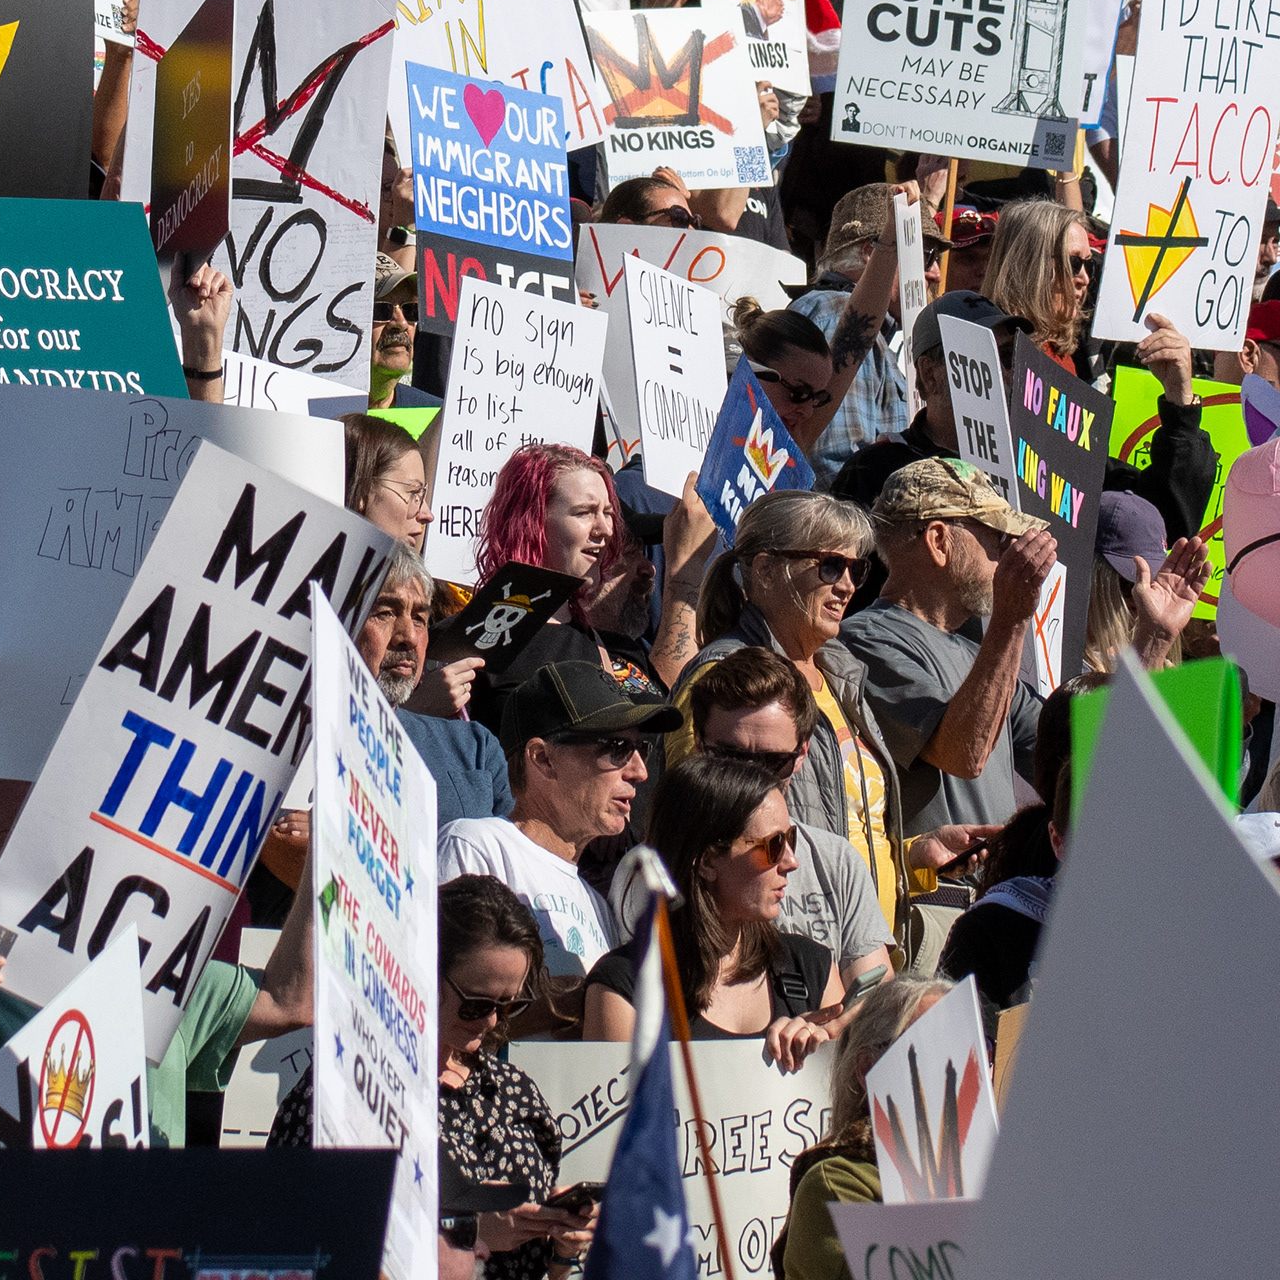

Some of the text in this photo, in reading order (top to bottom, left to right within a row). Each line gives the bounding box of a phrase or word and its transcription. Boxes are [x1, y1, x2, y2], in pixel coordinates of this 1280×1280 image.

[866, 2, 1002, 57] CUTS
[845, 76, 986, 111] NECESSARY
[900, 54, 989, 84] MAY BE
[1182, 34, 1264, 96] THAT
[412, 84, 460, 130] WE
[504, 102, 561, 150] OUR
[610, 130, 715, 153] NO KINGS
[862, 121, 1040, 157] DON'T MOURN ORGANIZE
[418, 132, 566, 196] IMMIGRANT
[416, 174, 570, 248] NEIGHBORS
[1209, 209, 1251, 268] TO
[639, 270, 699, 337] SILENCE
[1194, 267, 1246, 336] GO!
[37, 329, 82, 351] our
[463, 338, 594, 405] is big enough
[457, 386, 523, 423] to list
[948, 350, 992, 401] STOP
[452, 429, 507, 452] all of
[962, 415, 1000, 465] THE
[1023, 368, 1096, 452] NO FAUX
[1017, 436, 1047, 500] KING
[1050, 472, 1085, 529] WAY
[346, 646, 403, 767] WE THE
[350, 693, 402, 807] PEOPLE
[349, 768, 400, 879] NEVER
[347, 808, 403, 921] FORGET
[365, 921, 427, 1034] COWARDS
[361, 952, 419, 1077] CONGRESS
